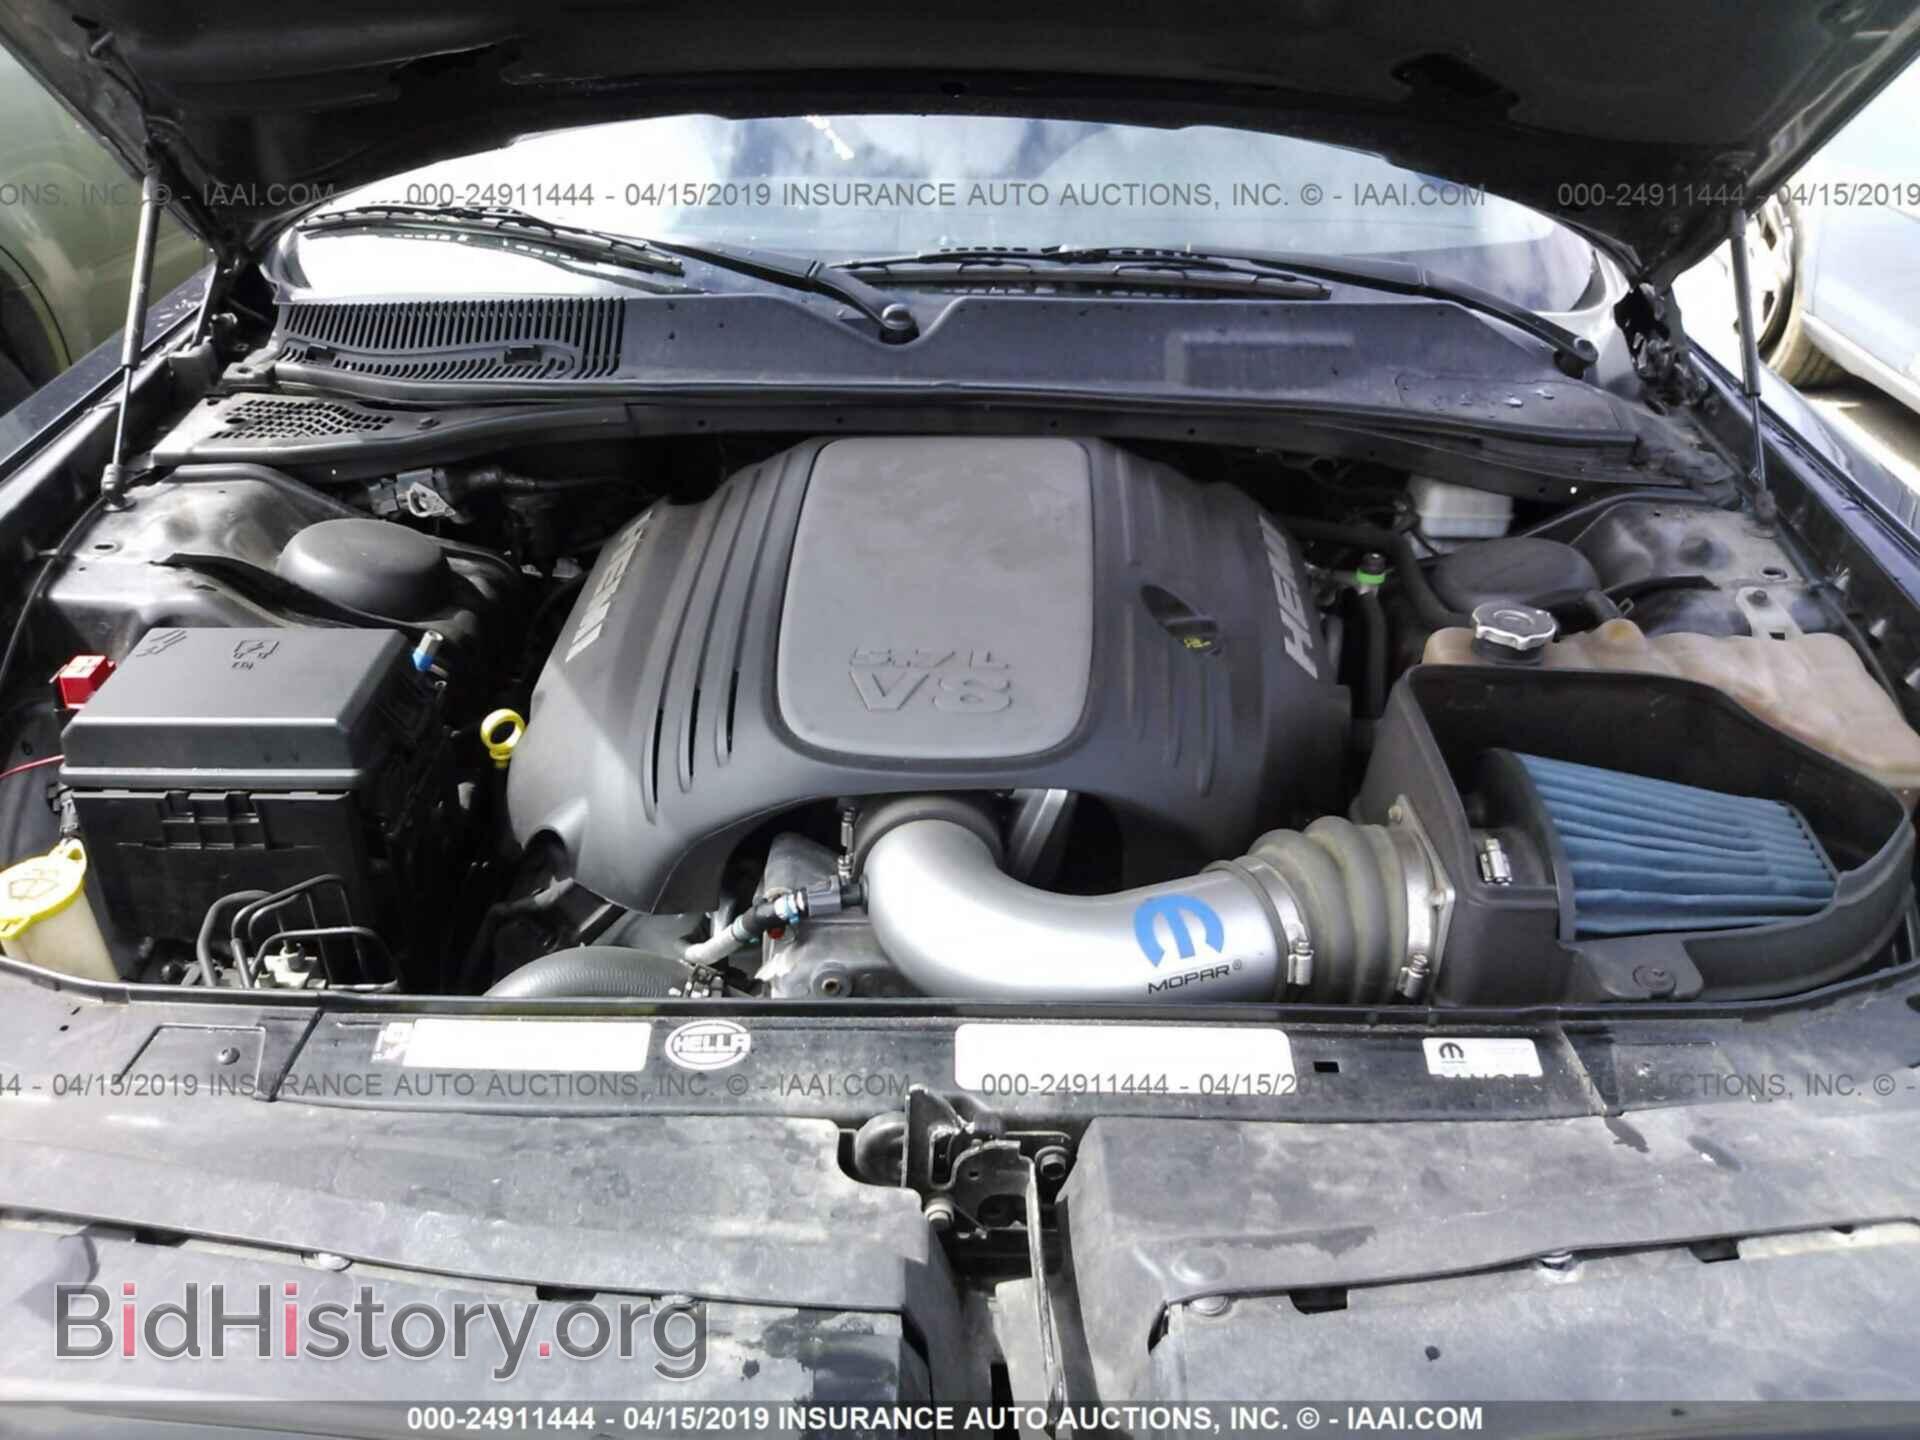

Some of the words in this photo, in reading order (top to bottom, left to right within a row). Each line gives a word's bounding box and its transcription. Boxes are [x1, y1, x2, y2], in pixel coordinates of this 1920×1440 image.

[1258, 514, 1319, 681] HEMI
[848, 671, 1013, 715] V8
[672, 1032, 751, 1053] HELLA
